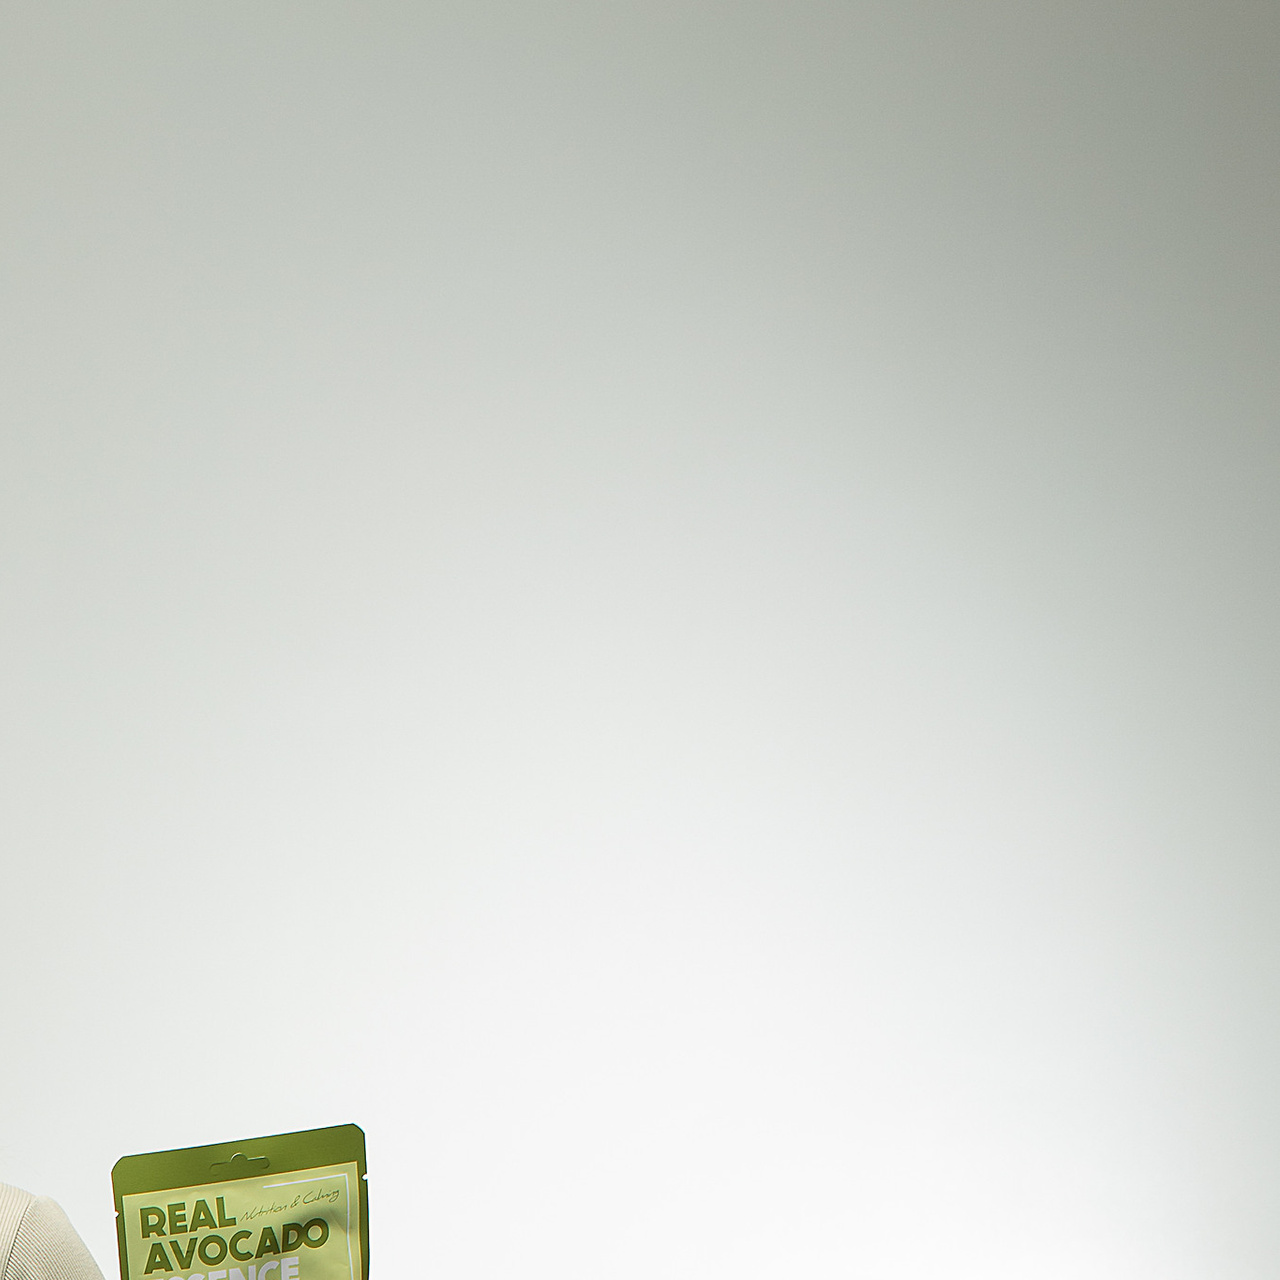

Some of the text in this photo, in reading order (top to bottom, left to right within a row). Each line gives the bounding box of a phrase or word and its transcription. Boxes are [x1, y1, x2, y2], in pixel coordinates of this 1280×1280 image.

[140, 1196, 237, 1239] REAL
[290, 1194, 301, 1209] &
[144, 1218, 330, 1275] AVOCADO
